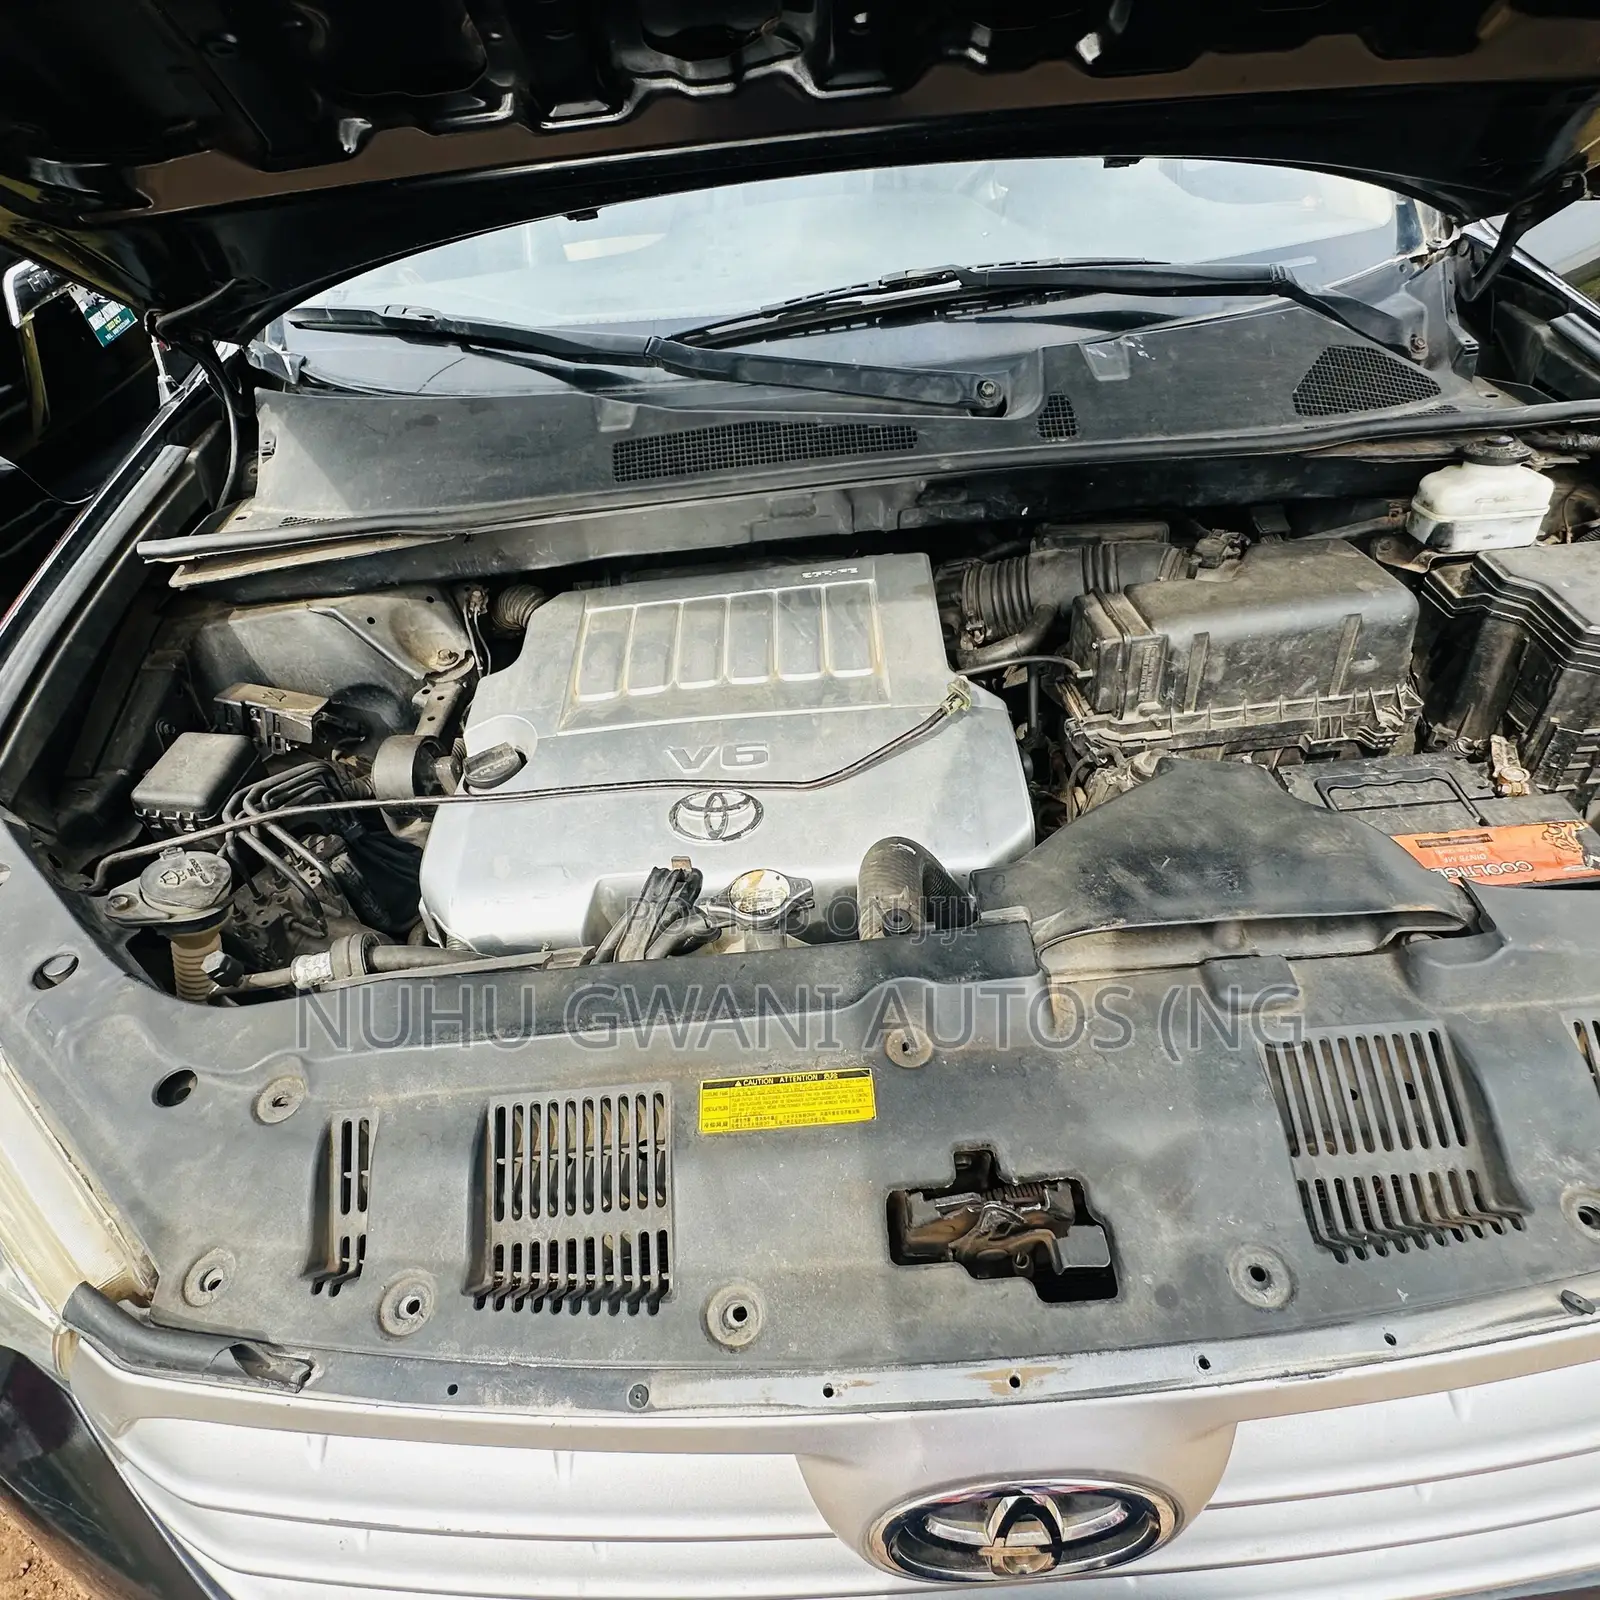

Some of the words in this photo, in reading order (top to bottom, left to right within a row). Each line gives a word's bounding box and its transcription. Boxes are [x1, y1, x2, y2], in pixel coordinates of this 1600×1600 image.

[664, 742, 769, 774] V6
[742, 1077, 774, 1087] CAUTION
[779, 1073, 818, 1083] ATTENTION
